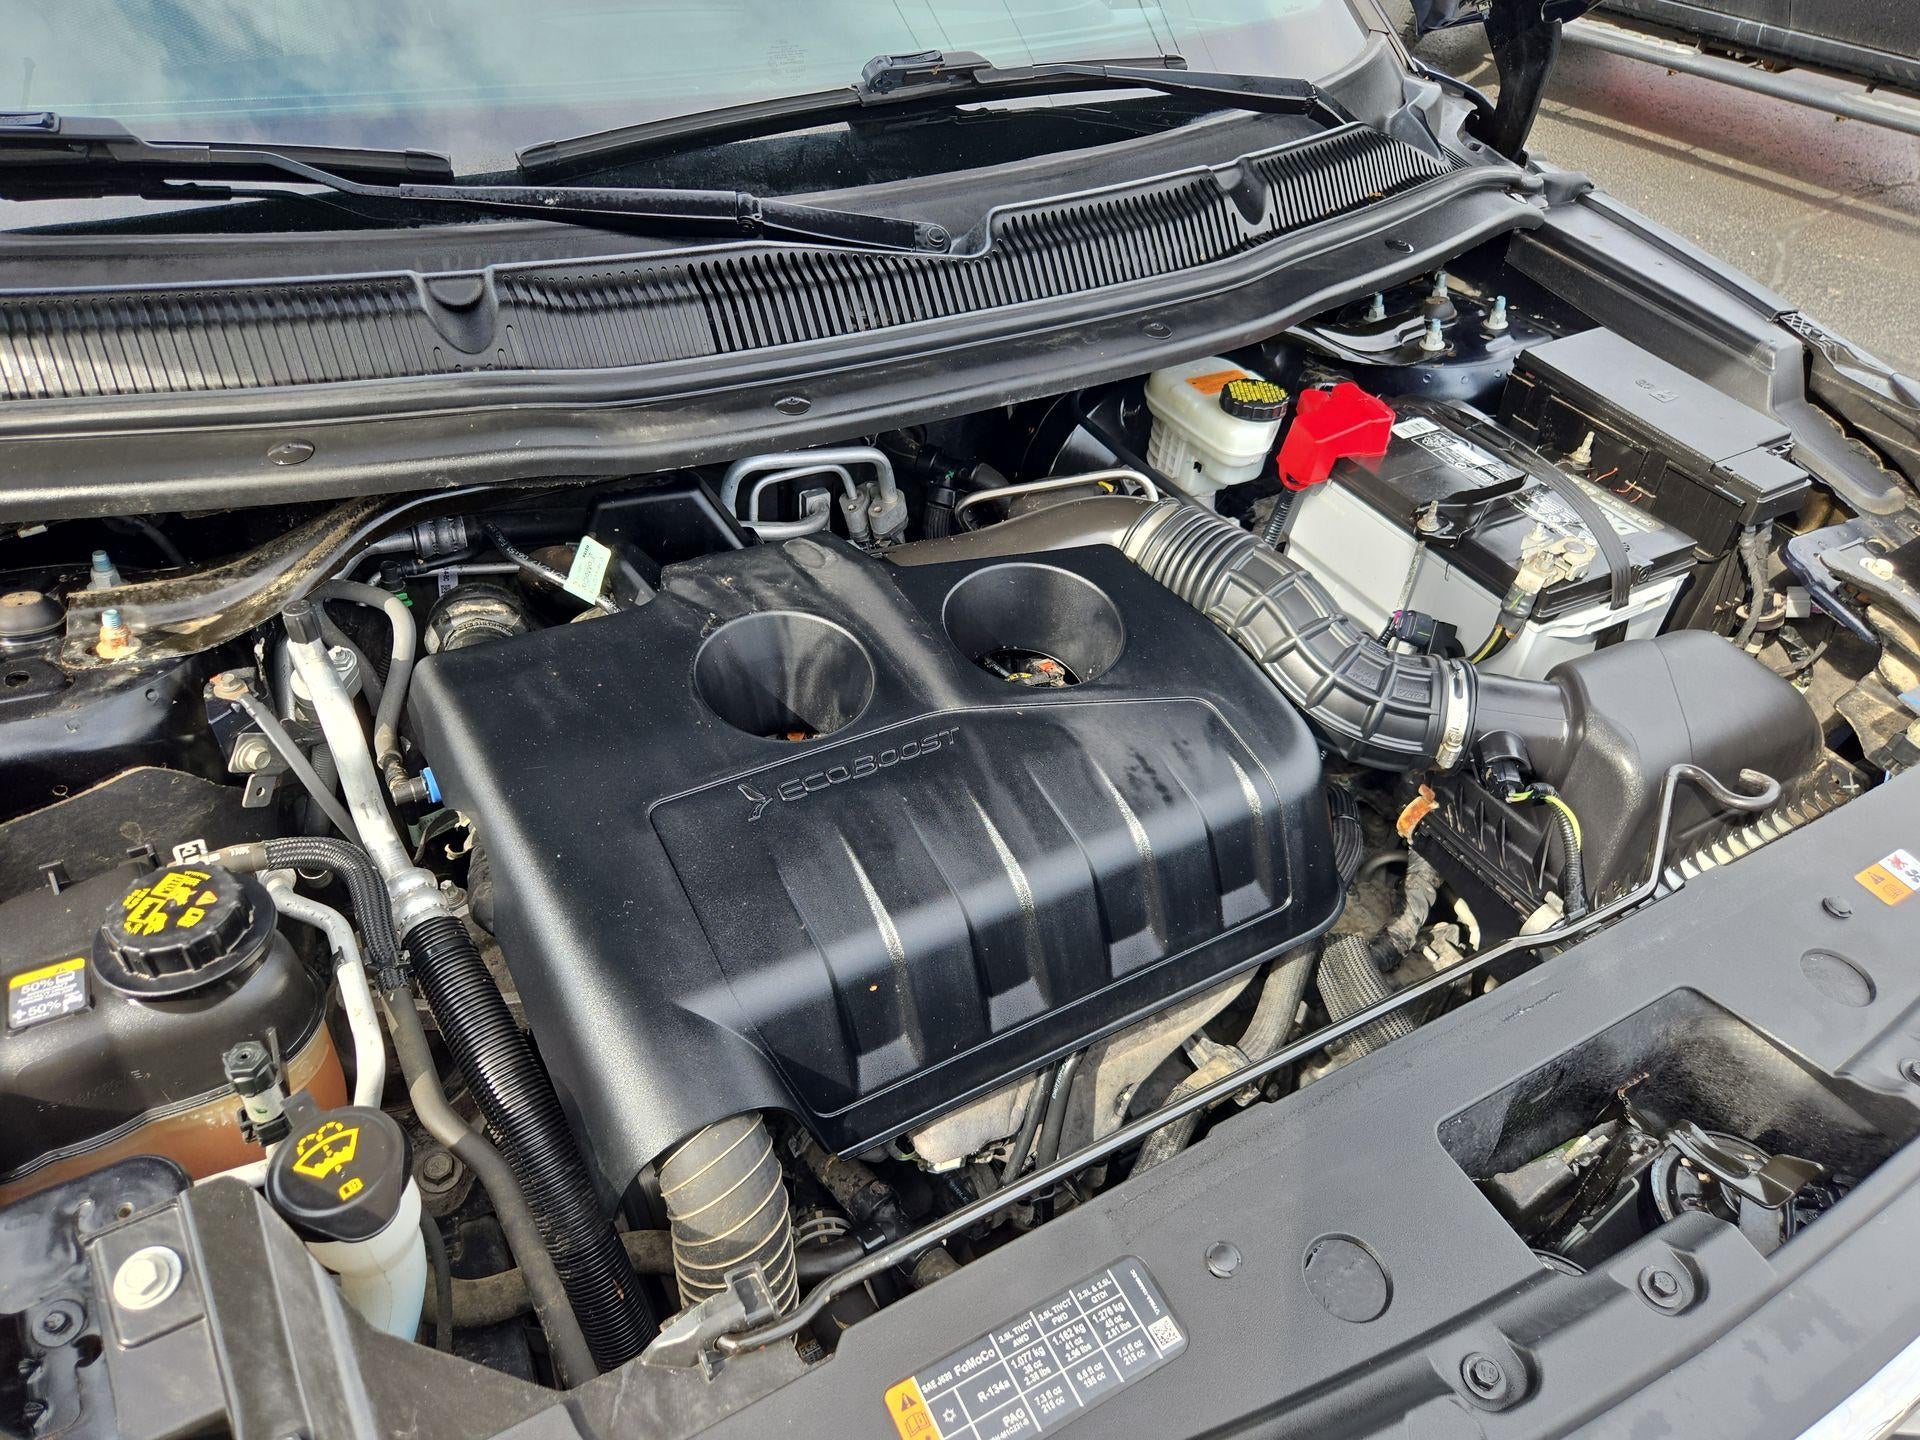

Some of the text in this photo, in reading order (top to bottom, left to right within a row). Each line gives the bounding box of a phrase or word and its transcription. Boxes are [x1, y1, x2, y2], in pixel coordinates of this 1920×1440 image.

[21, 978, 54, 995] 50%
[1112, 1301, 1126, 1313] kg
[1052, 1312, 1069, 1326] FWD
[1113, 1314, 1124, 1324] oz
[1073, 1322, 1087, 1335] kg
[1119, 1320, 1132, 1333] lbs
[1012, 1333, 1030, 1348] AWD
[1064, 1335, 1084, 1350] 41 oz
[1080, 1342, 1092, 1356] lbs
[1011, 1345, 1046, 1369] 1.077 kg
[921, 1379, 937, 1393] SAE
[954, 1348, 996, 1377] FoMoCo
[1033, 1360, 1043, 1369] oz
[1039, 1366, 1052, 1379] lbs
[977, 1379, 1011, 1403] R-134a
[1002, 1407, 1026, 1428] PAG
